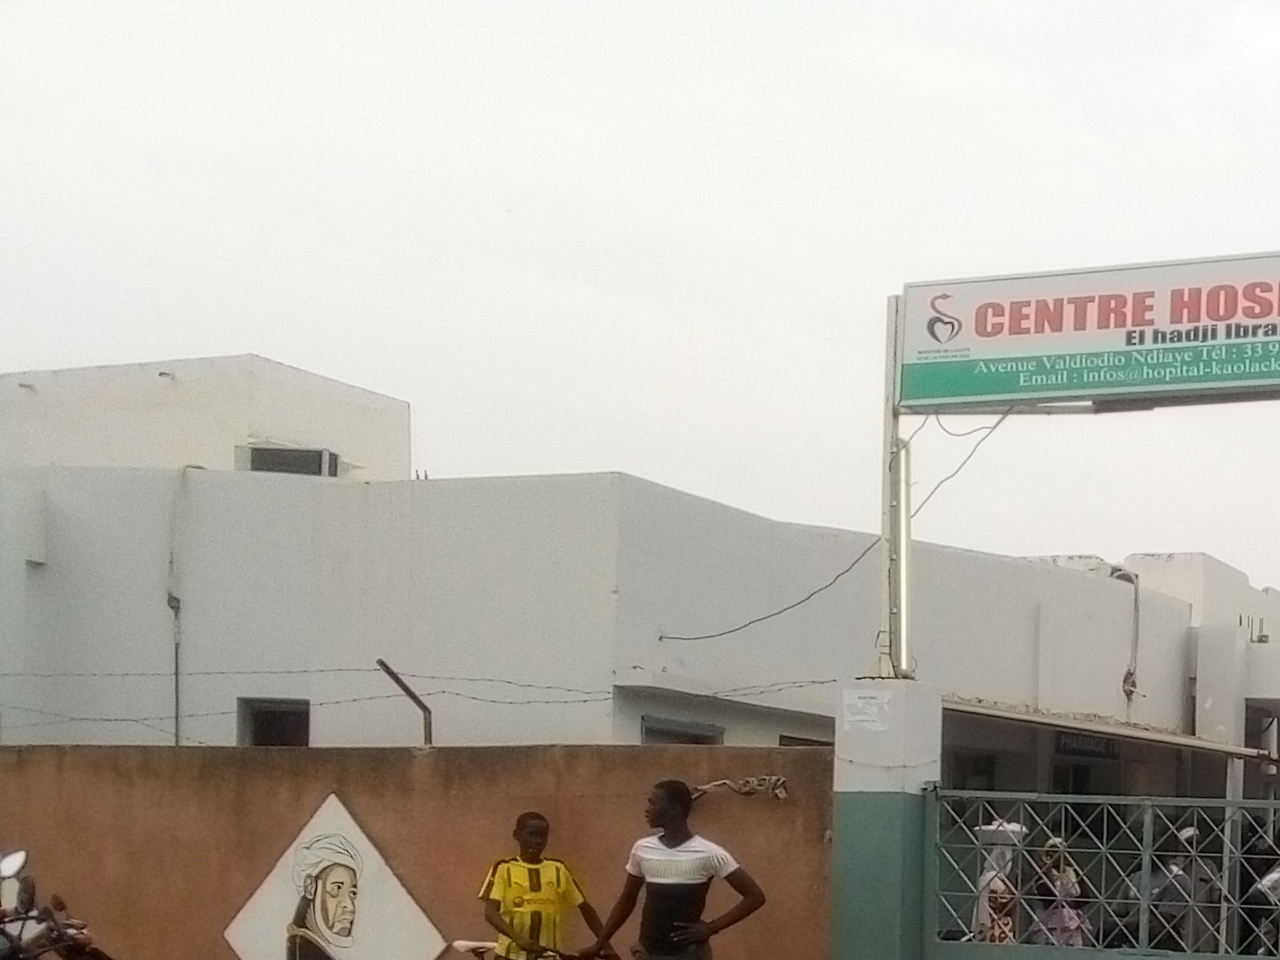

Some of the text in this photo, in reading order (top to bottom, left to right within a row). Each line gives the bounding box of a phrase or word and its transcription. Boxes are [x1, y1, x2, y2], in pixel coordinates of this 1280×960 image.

[974, 291, 1155, 338] CENTRE
[1126, 329, 1146, 346] El
[1152, 324, 1218, 343] hadji
[974, 360, 1037, 374] Avenue
[1042, 351, 1125, 369] Valdiodio
[1131, 349, 1193, 366] Ndiaye
[1243, 343, 1262, 358] 33
[1018, 370, 1068, 386] Email
